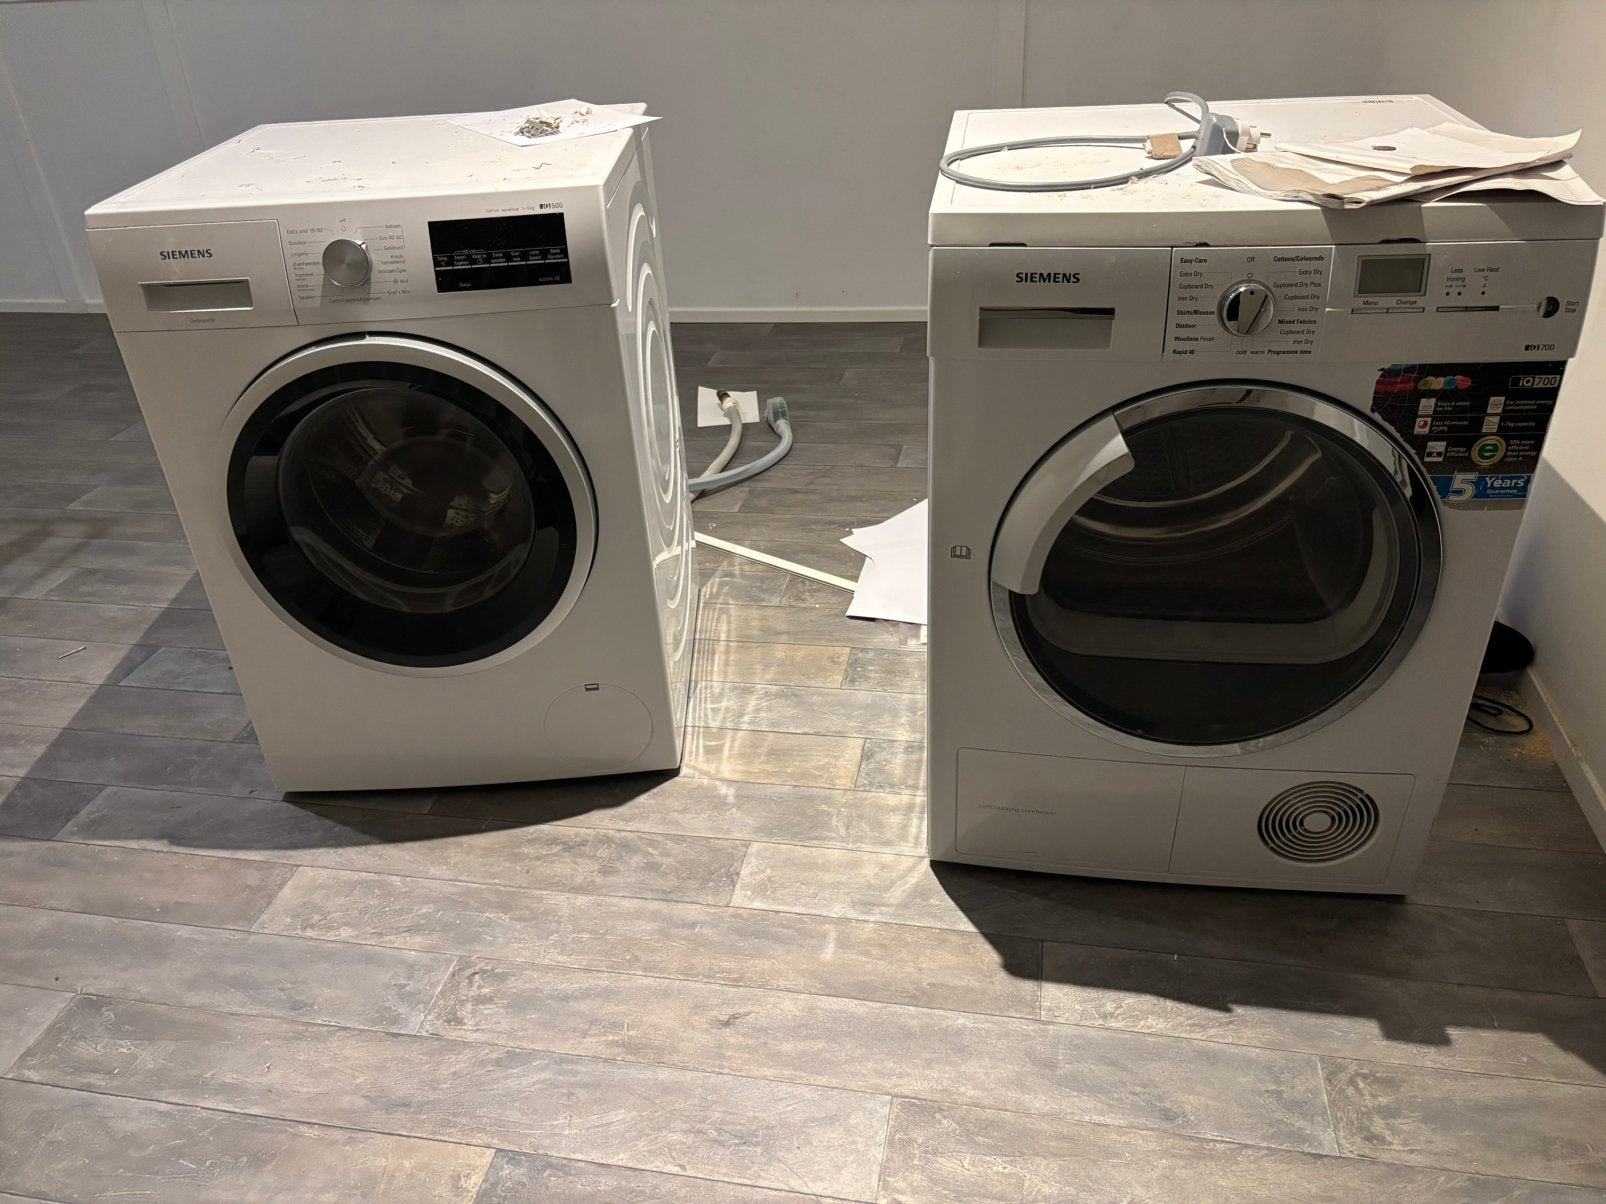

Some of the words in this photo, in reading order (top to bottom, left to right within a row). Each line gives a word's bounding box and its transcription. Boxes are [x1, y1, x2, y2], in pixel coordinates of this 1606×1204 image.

[159, 248, 213, 260] SIEMENS
[1180, 257, 1208, 265] Easy-Care
[1273, 255, 1325, 263] Cottons/Coloureds
[1193, 271, 1203, 279] Dry
[1313, 269, 1323, 277] Dry
[1015, 272, 1080, 284] SIEMENS
[1446, 275, 1466, 283] Ironing
[1178, 283, 1201, 291] Cupboard
[1202, 283, 1214, 291] Dry
[1299, 281, 1309, 289] Dry
[1189, 295, 1199, 303] Dry
[1519, 377, 1533, 387] iQ
[1535, 376, 1558, 386] 700
[1446, 472, 1479, 503] 5
